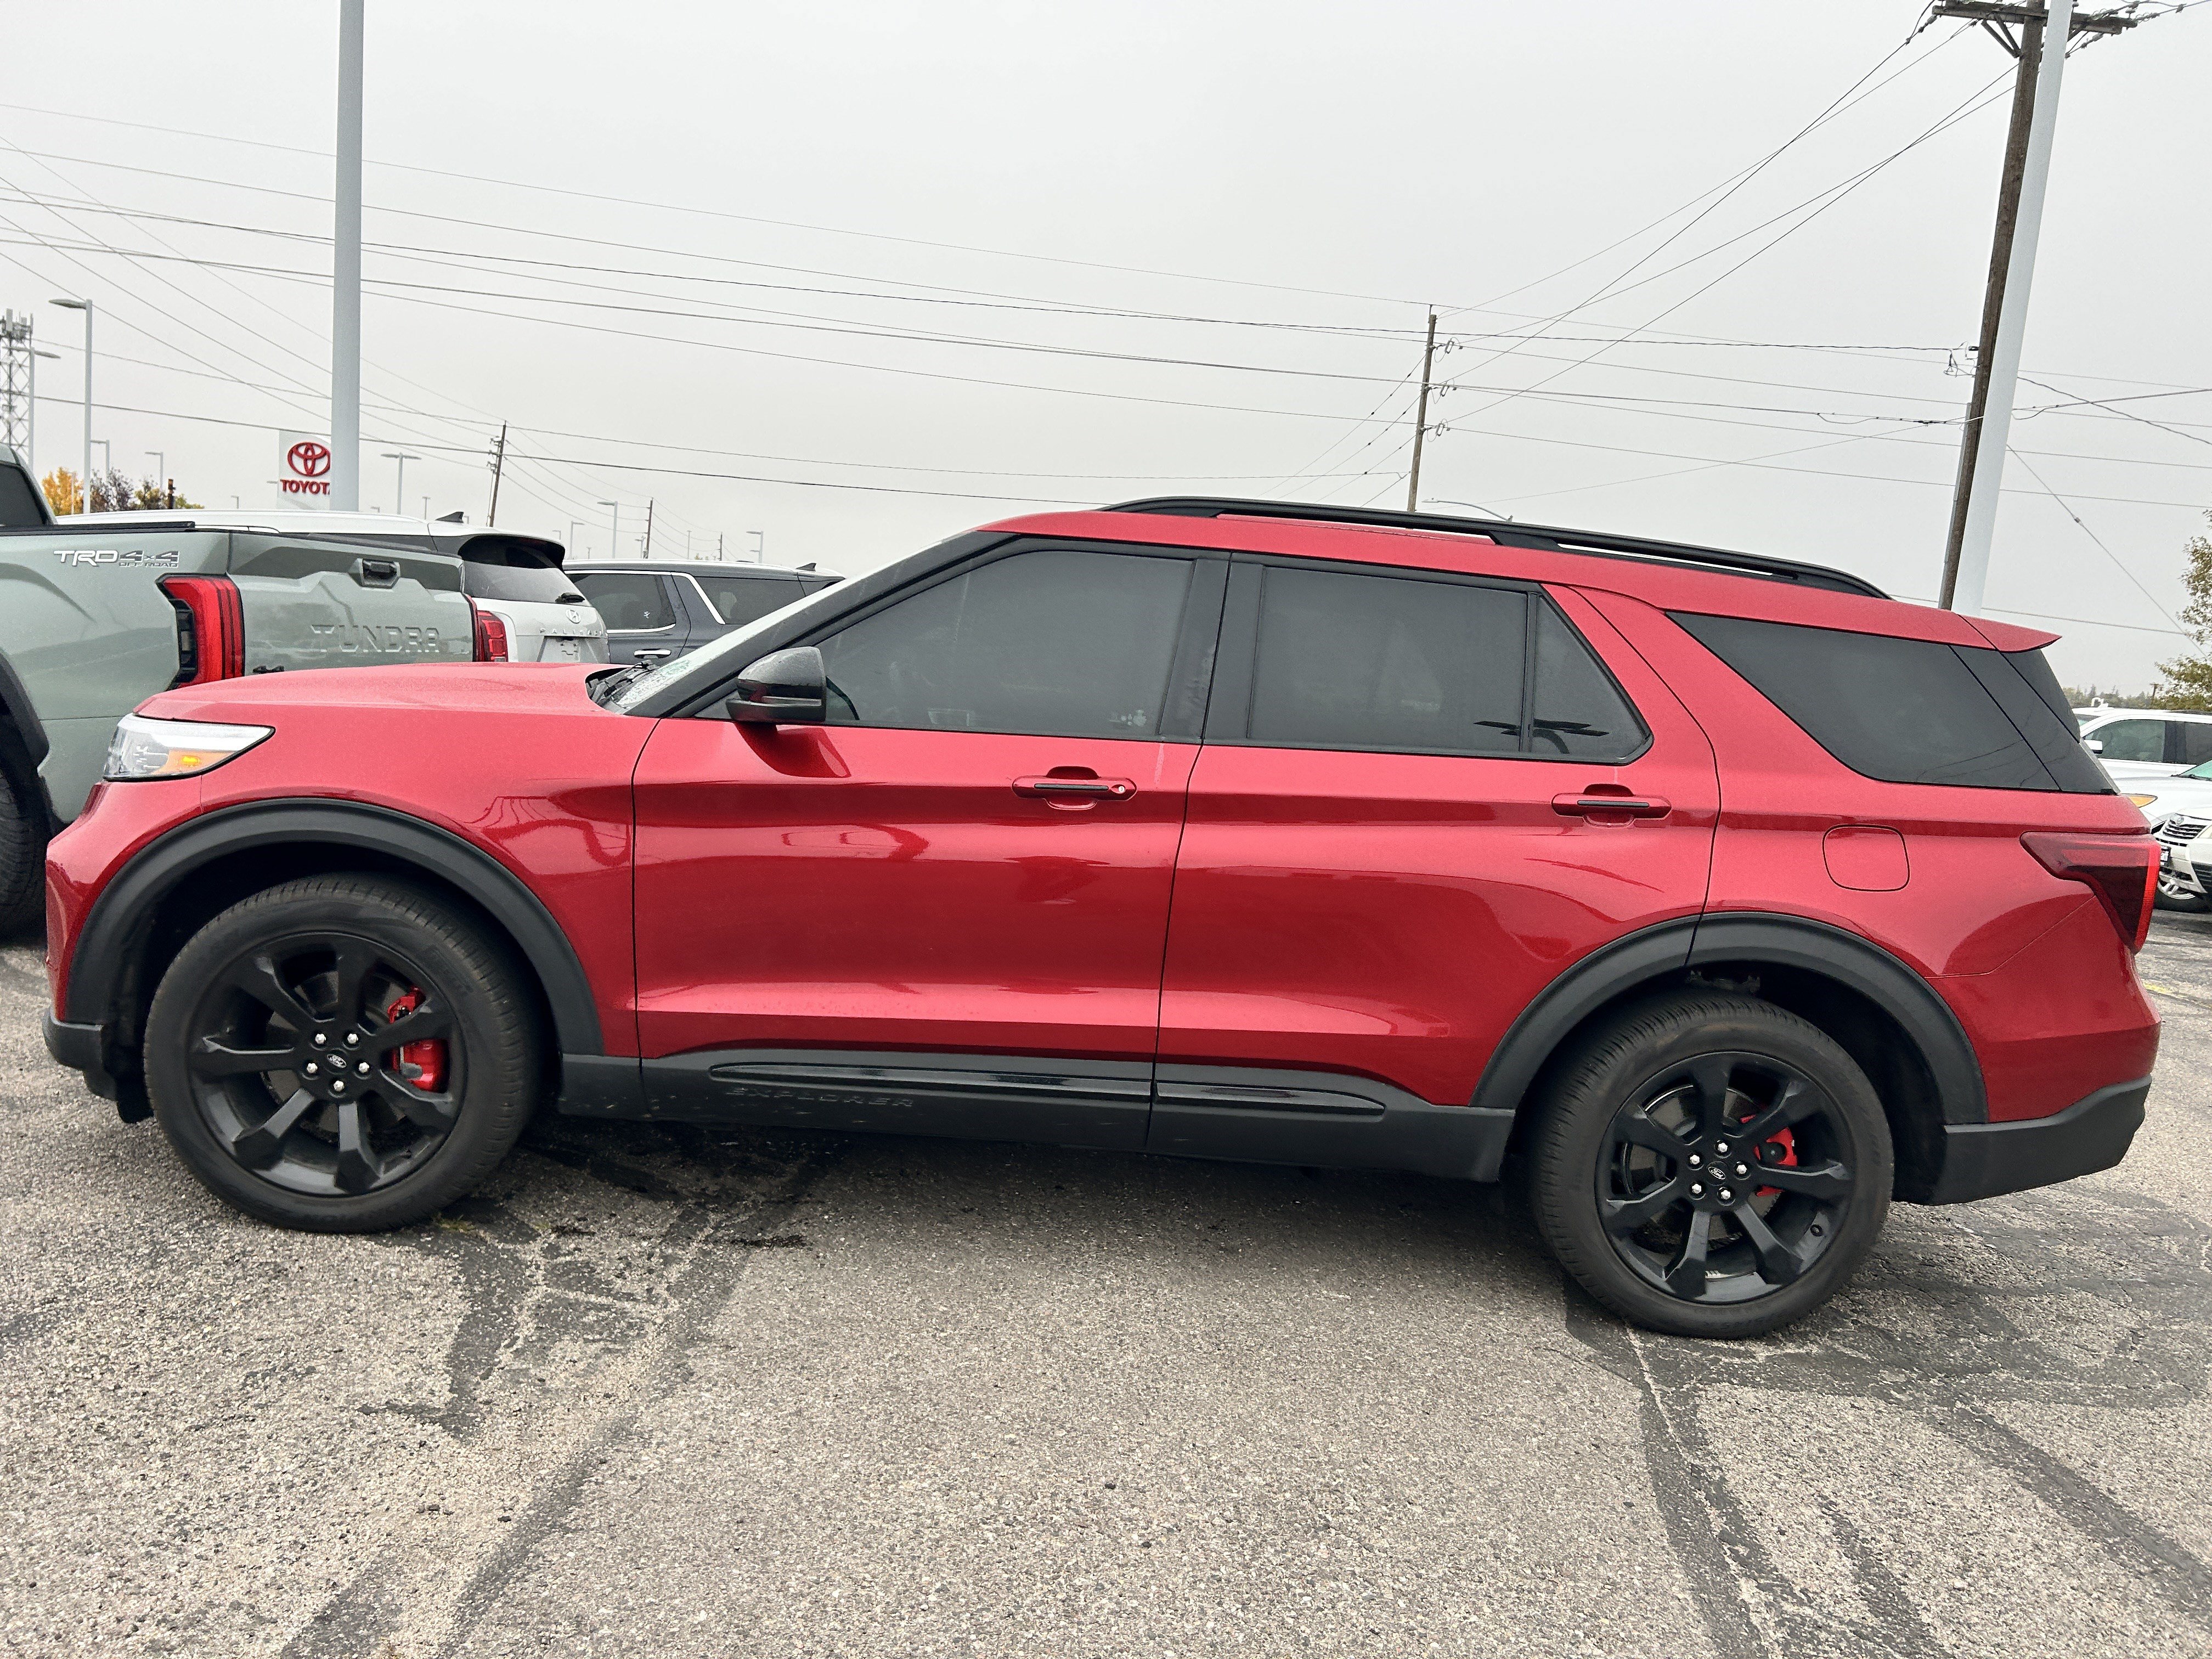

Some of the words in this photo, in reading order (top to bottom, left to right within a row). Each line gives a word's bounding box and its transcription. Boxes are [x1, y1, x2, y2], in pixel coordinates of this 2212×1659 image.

[280, 479, 330, 495] TOYOT
[53, 550, 119, 567] TRD
[310, 624, 439, 653] TUNDRA
[725, 1086, 913, 1108] EXPLORER
